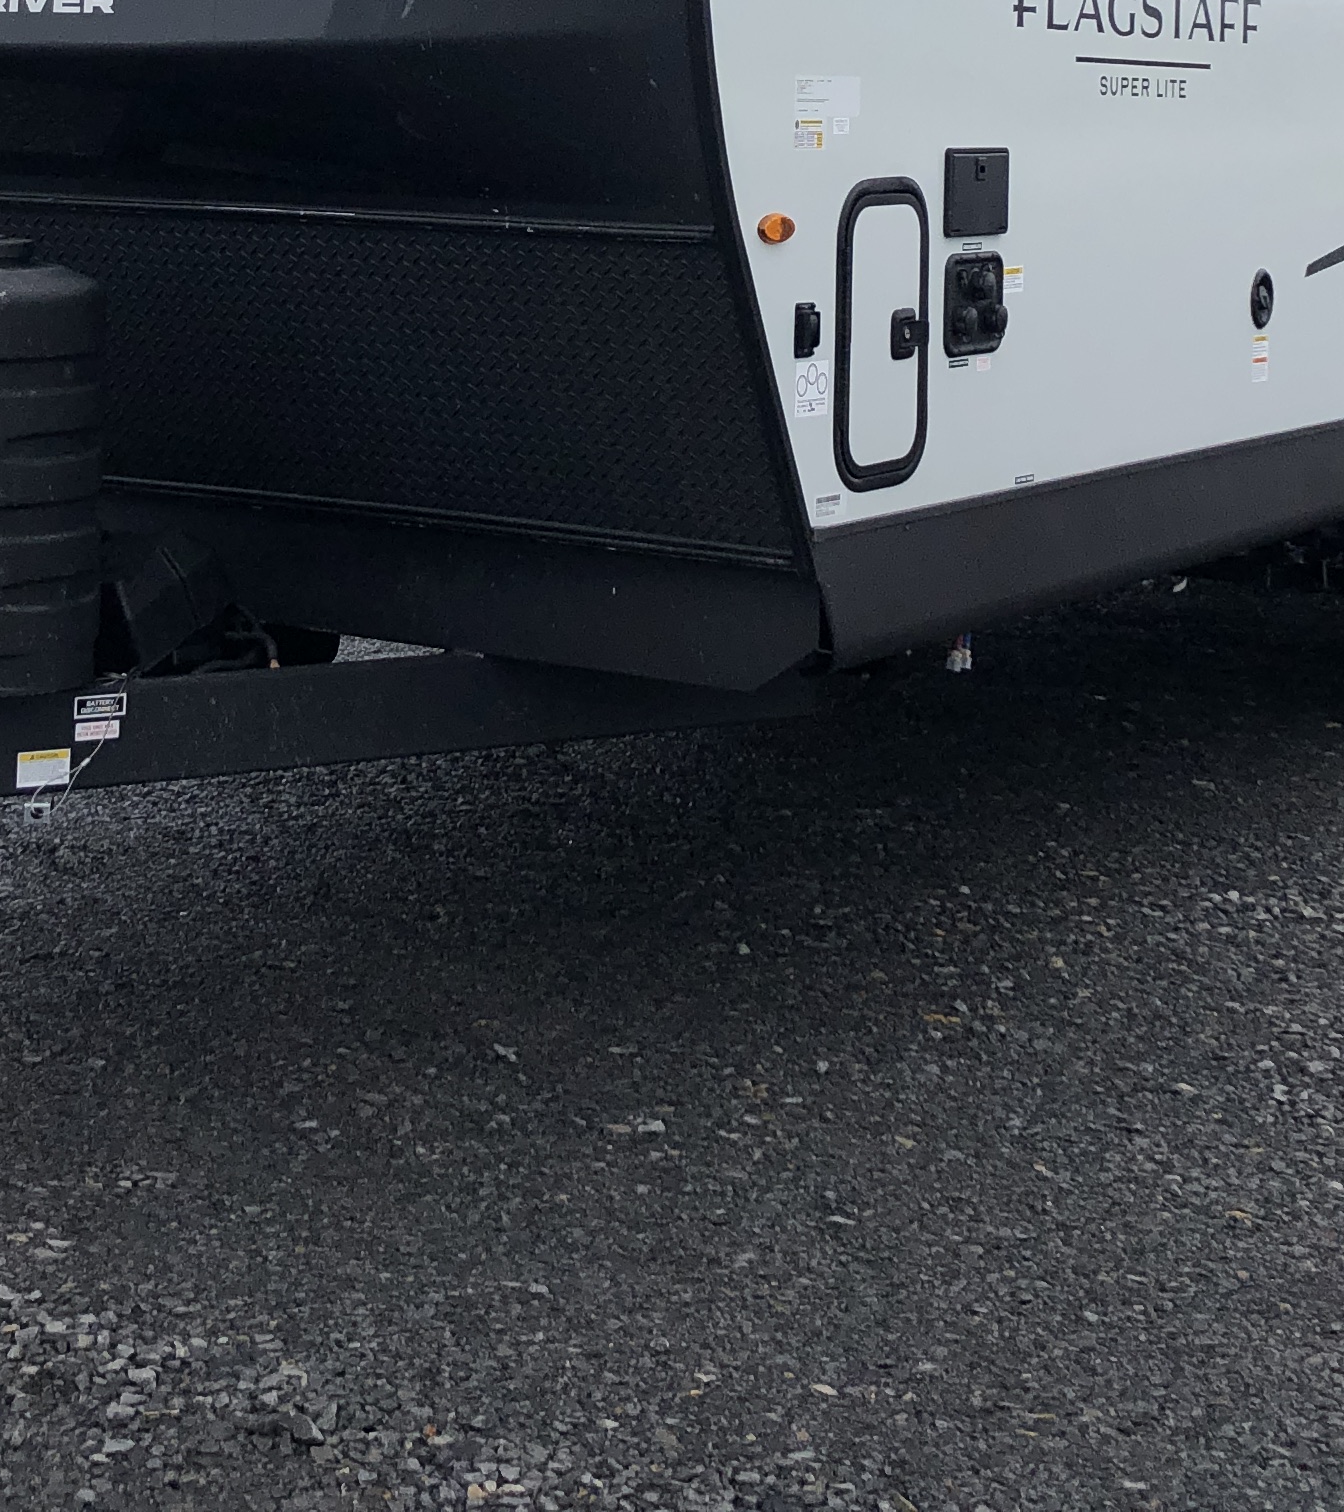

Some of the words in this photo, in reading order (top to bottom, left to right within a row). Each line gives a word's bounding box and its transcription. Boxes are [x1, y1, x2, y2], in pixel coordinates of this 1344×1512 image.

[1099, 75, 1151, 98] SUPER
[1156, 79, 1188, 99] LITE
[86, 699, 115, 707] BATTERY
